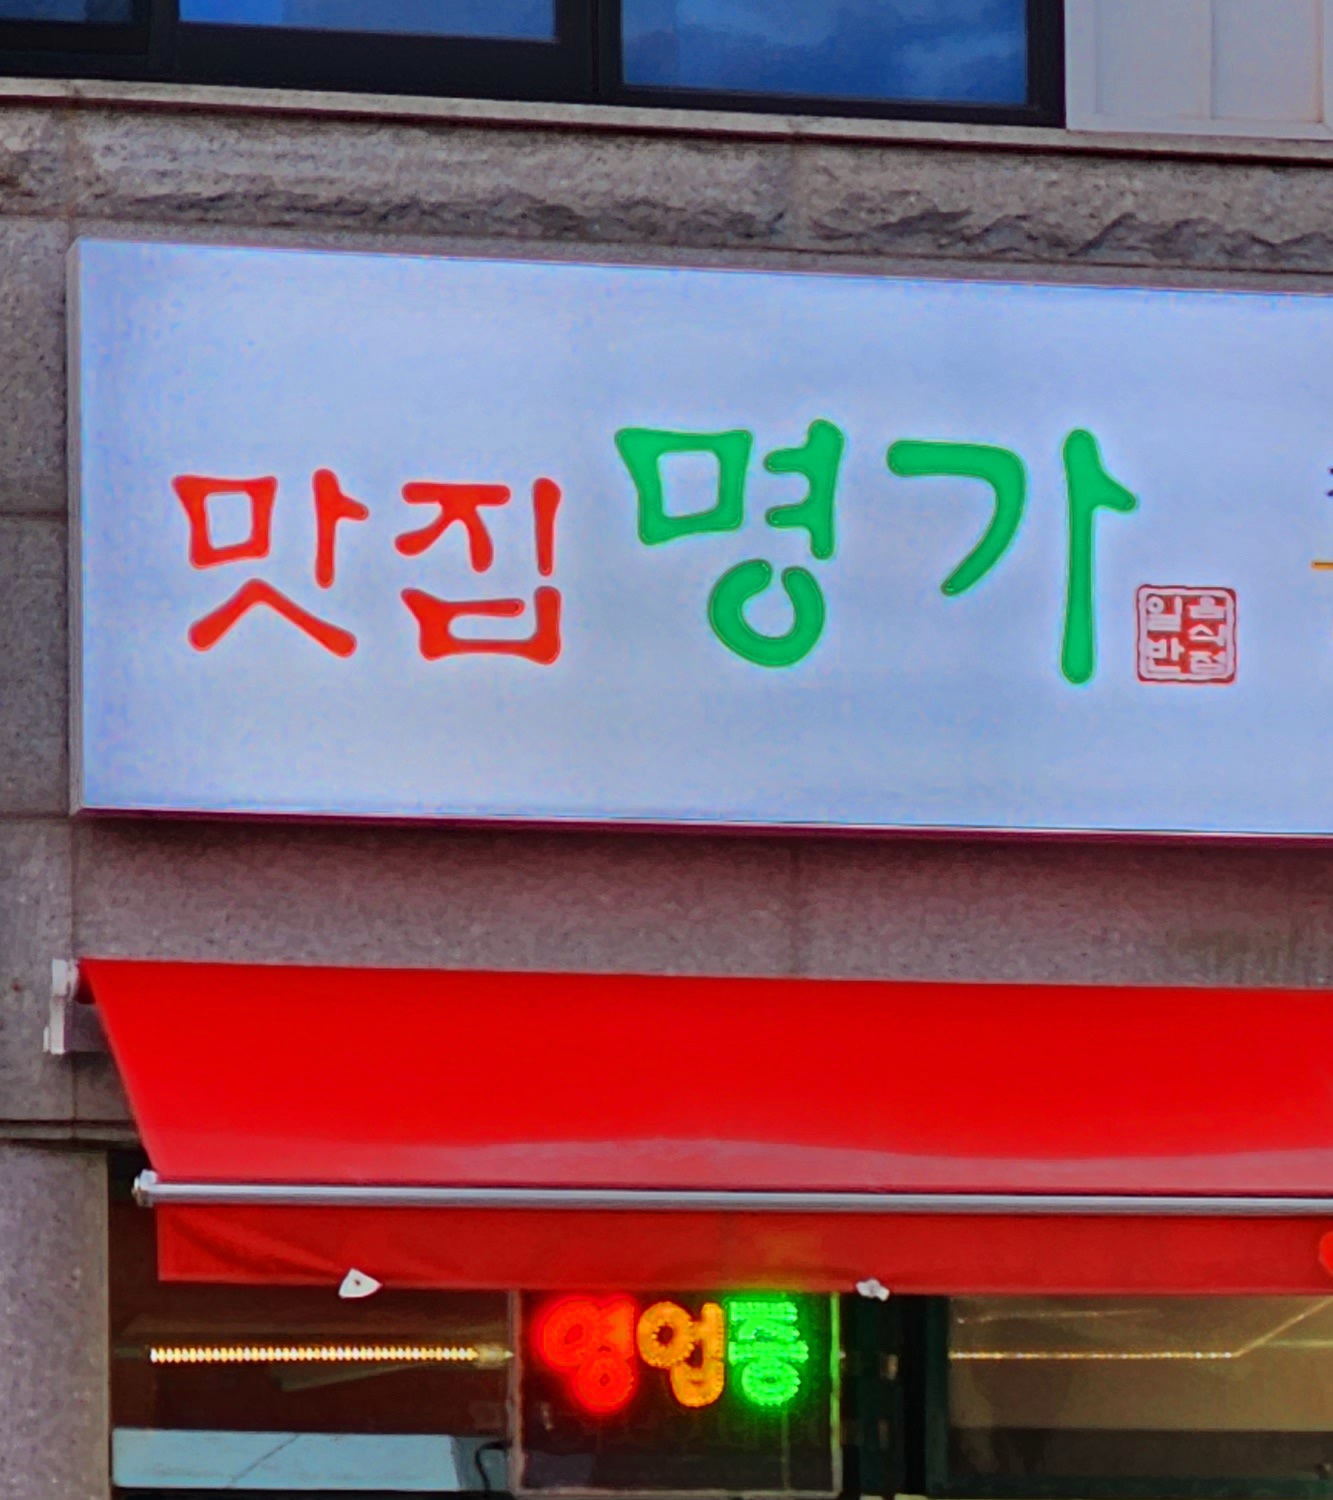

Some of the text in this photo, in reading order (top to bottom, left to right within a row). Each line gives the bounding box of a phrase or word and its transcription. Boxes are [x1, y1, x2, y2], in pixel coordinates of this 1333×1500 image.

[172, 418, 1136, 683] 맛집 명가
[541, 1298, 809, 1411] 영업중
